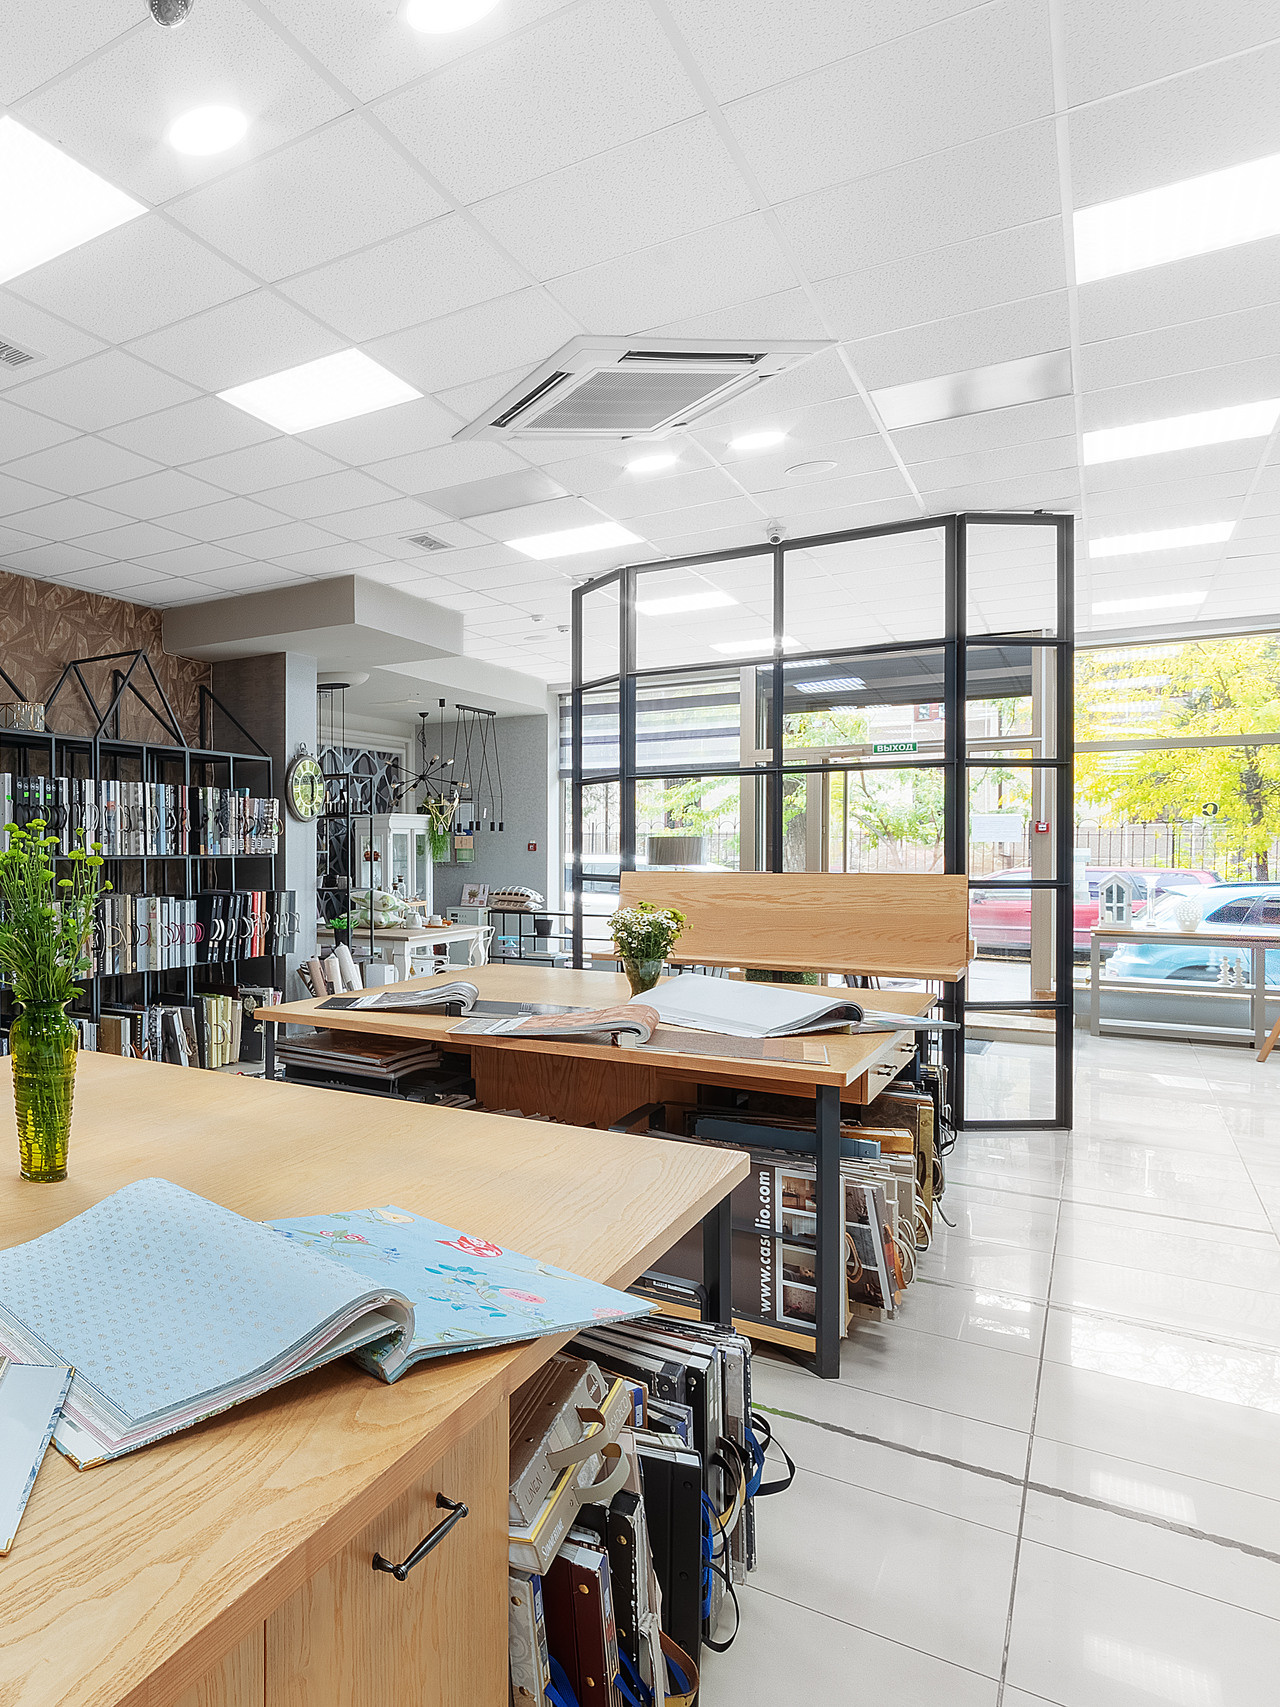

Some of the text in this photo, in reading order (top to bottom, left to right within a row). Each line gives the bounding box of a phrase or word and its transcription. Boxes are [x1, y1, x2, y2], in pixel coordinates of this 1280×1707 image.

[877, 743, 914, 752] ВЫХОД
[754, 1170, 771, 1312] www.caslio.com
[525, 1475, 544, 1506] LINEN
